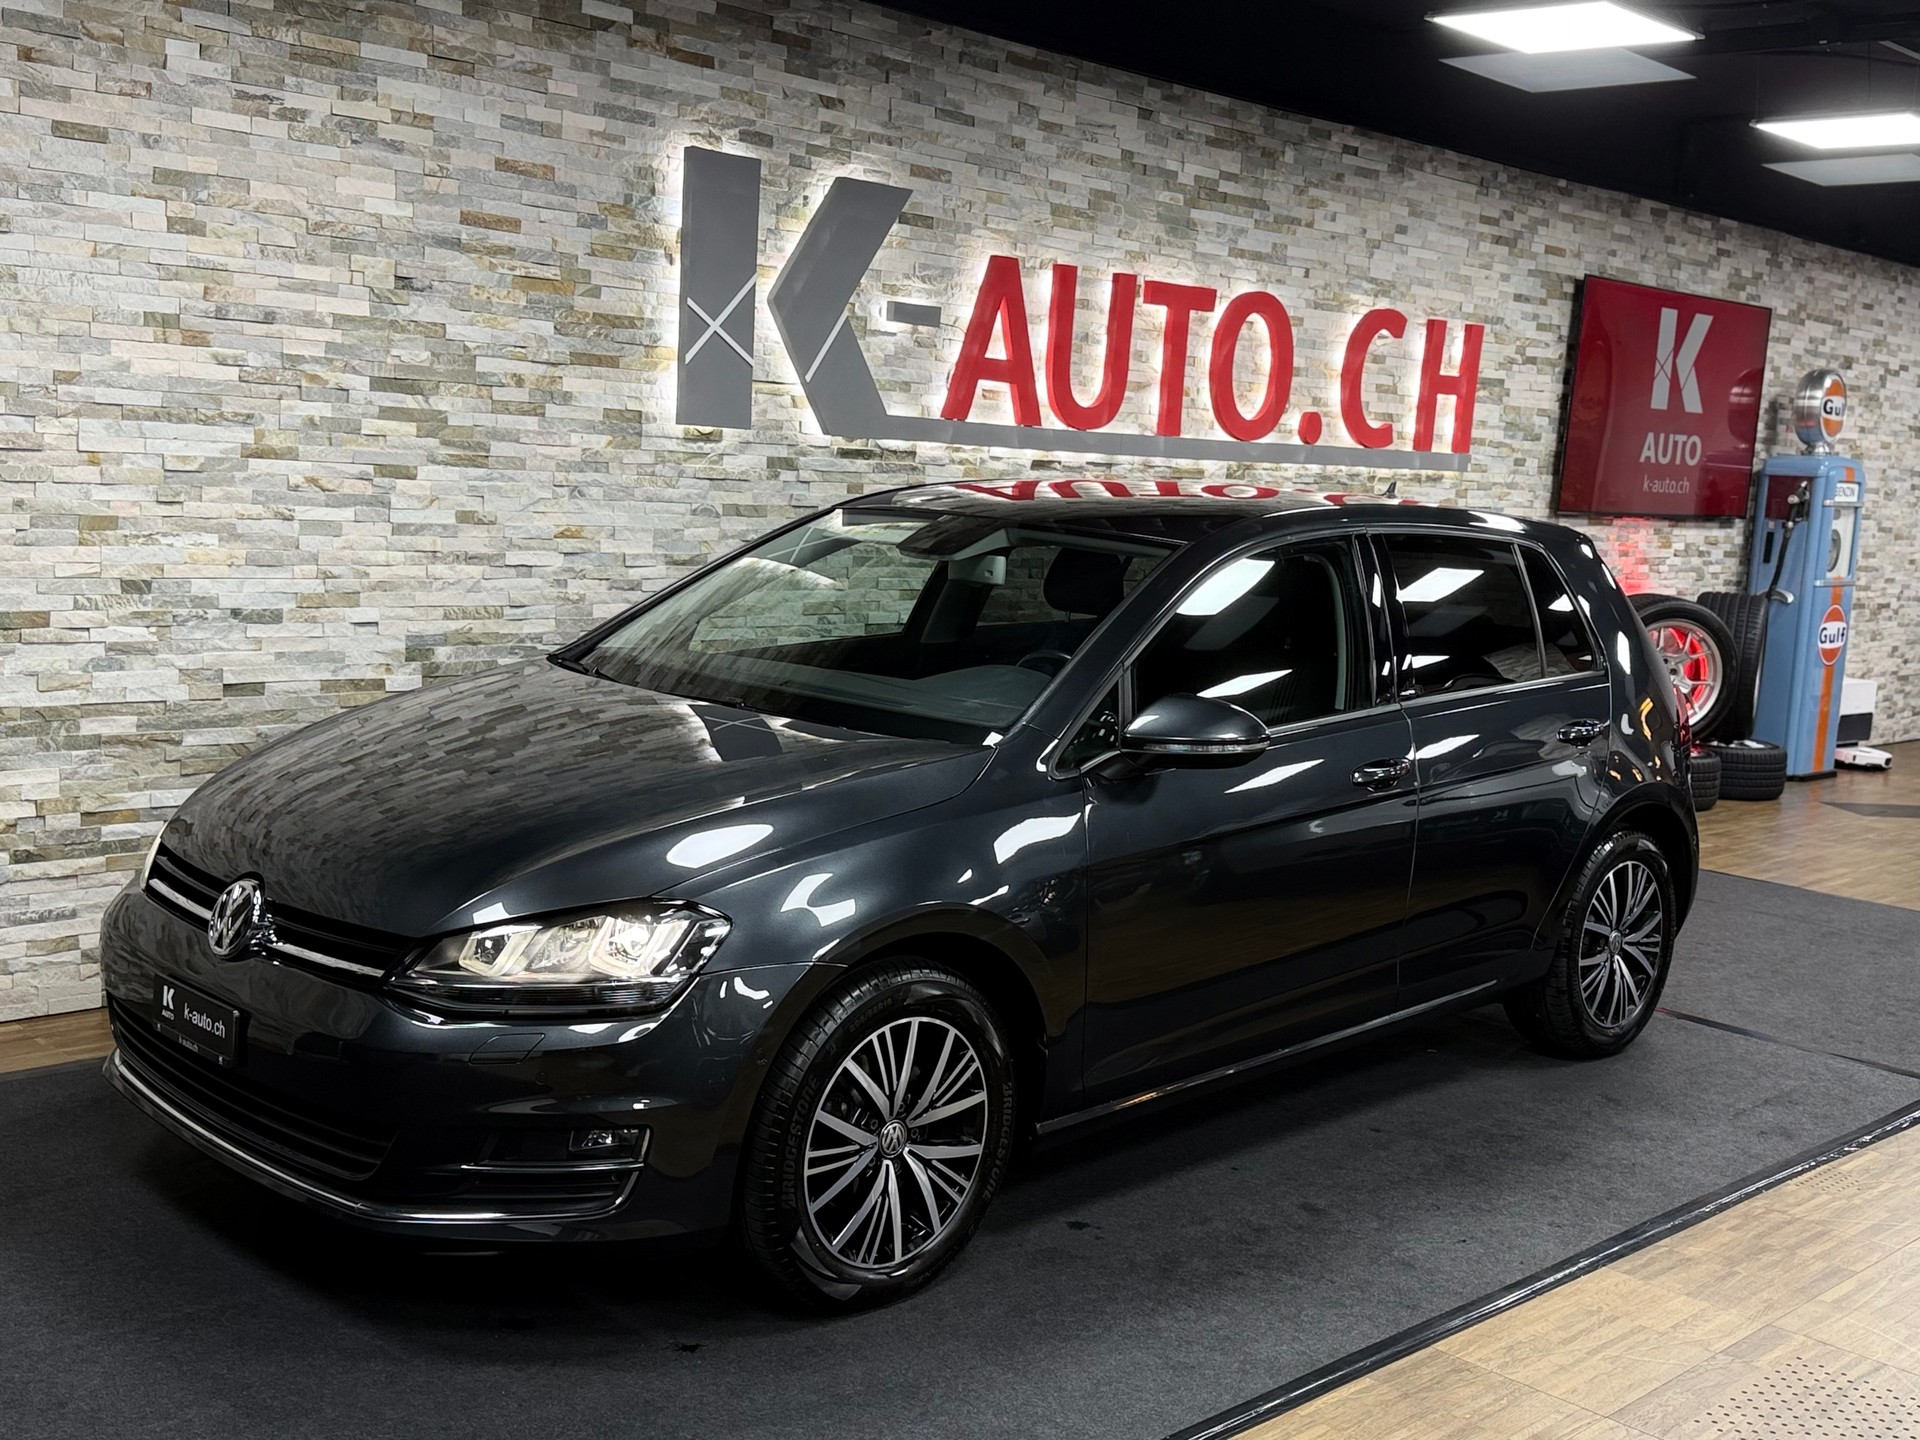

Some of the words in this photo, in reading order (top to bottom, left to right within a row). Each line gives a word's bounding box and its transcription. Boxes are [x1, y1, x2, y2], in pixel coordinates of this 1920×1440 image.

[676, 146, 1485, 456] K-AUTO.CH
[1651, 307, 1714, 414] K
[1823, 398, 1845, 416] Gul
[1639, 432, 1702, 466] AUTO
[1642, 476, 1690, 494] k-auto.ch
[1819, 626, 1847, 645] Gulf
[162, 985, 176, 1010] K
[183, 1002, 226, 1039] k-auto.ch
[781, 1074, 821, 1209] BRIDGESTONE
[983, 1082, 1014, 1204] BRIDGESTONE
